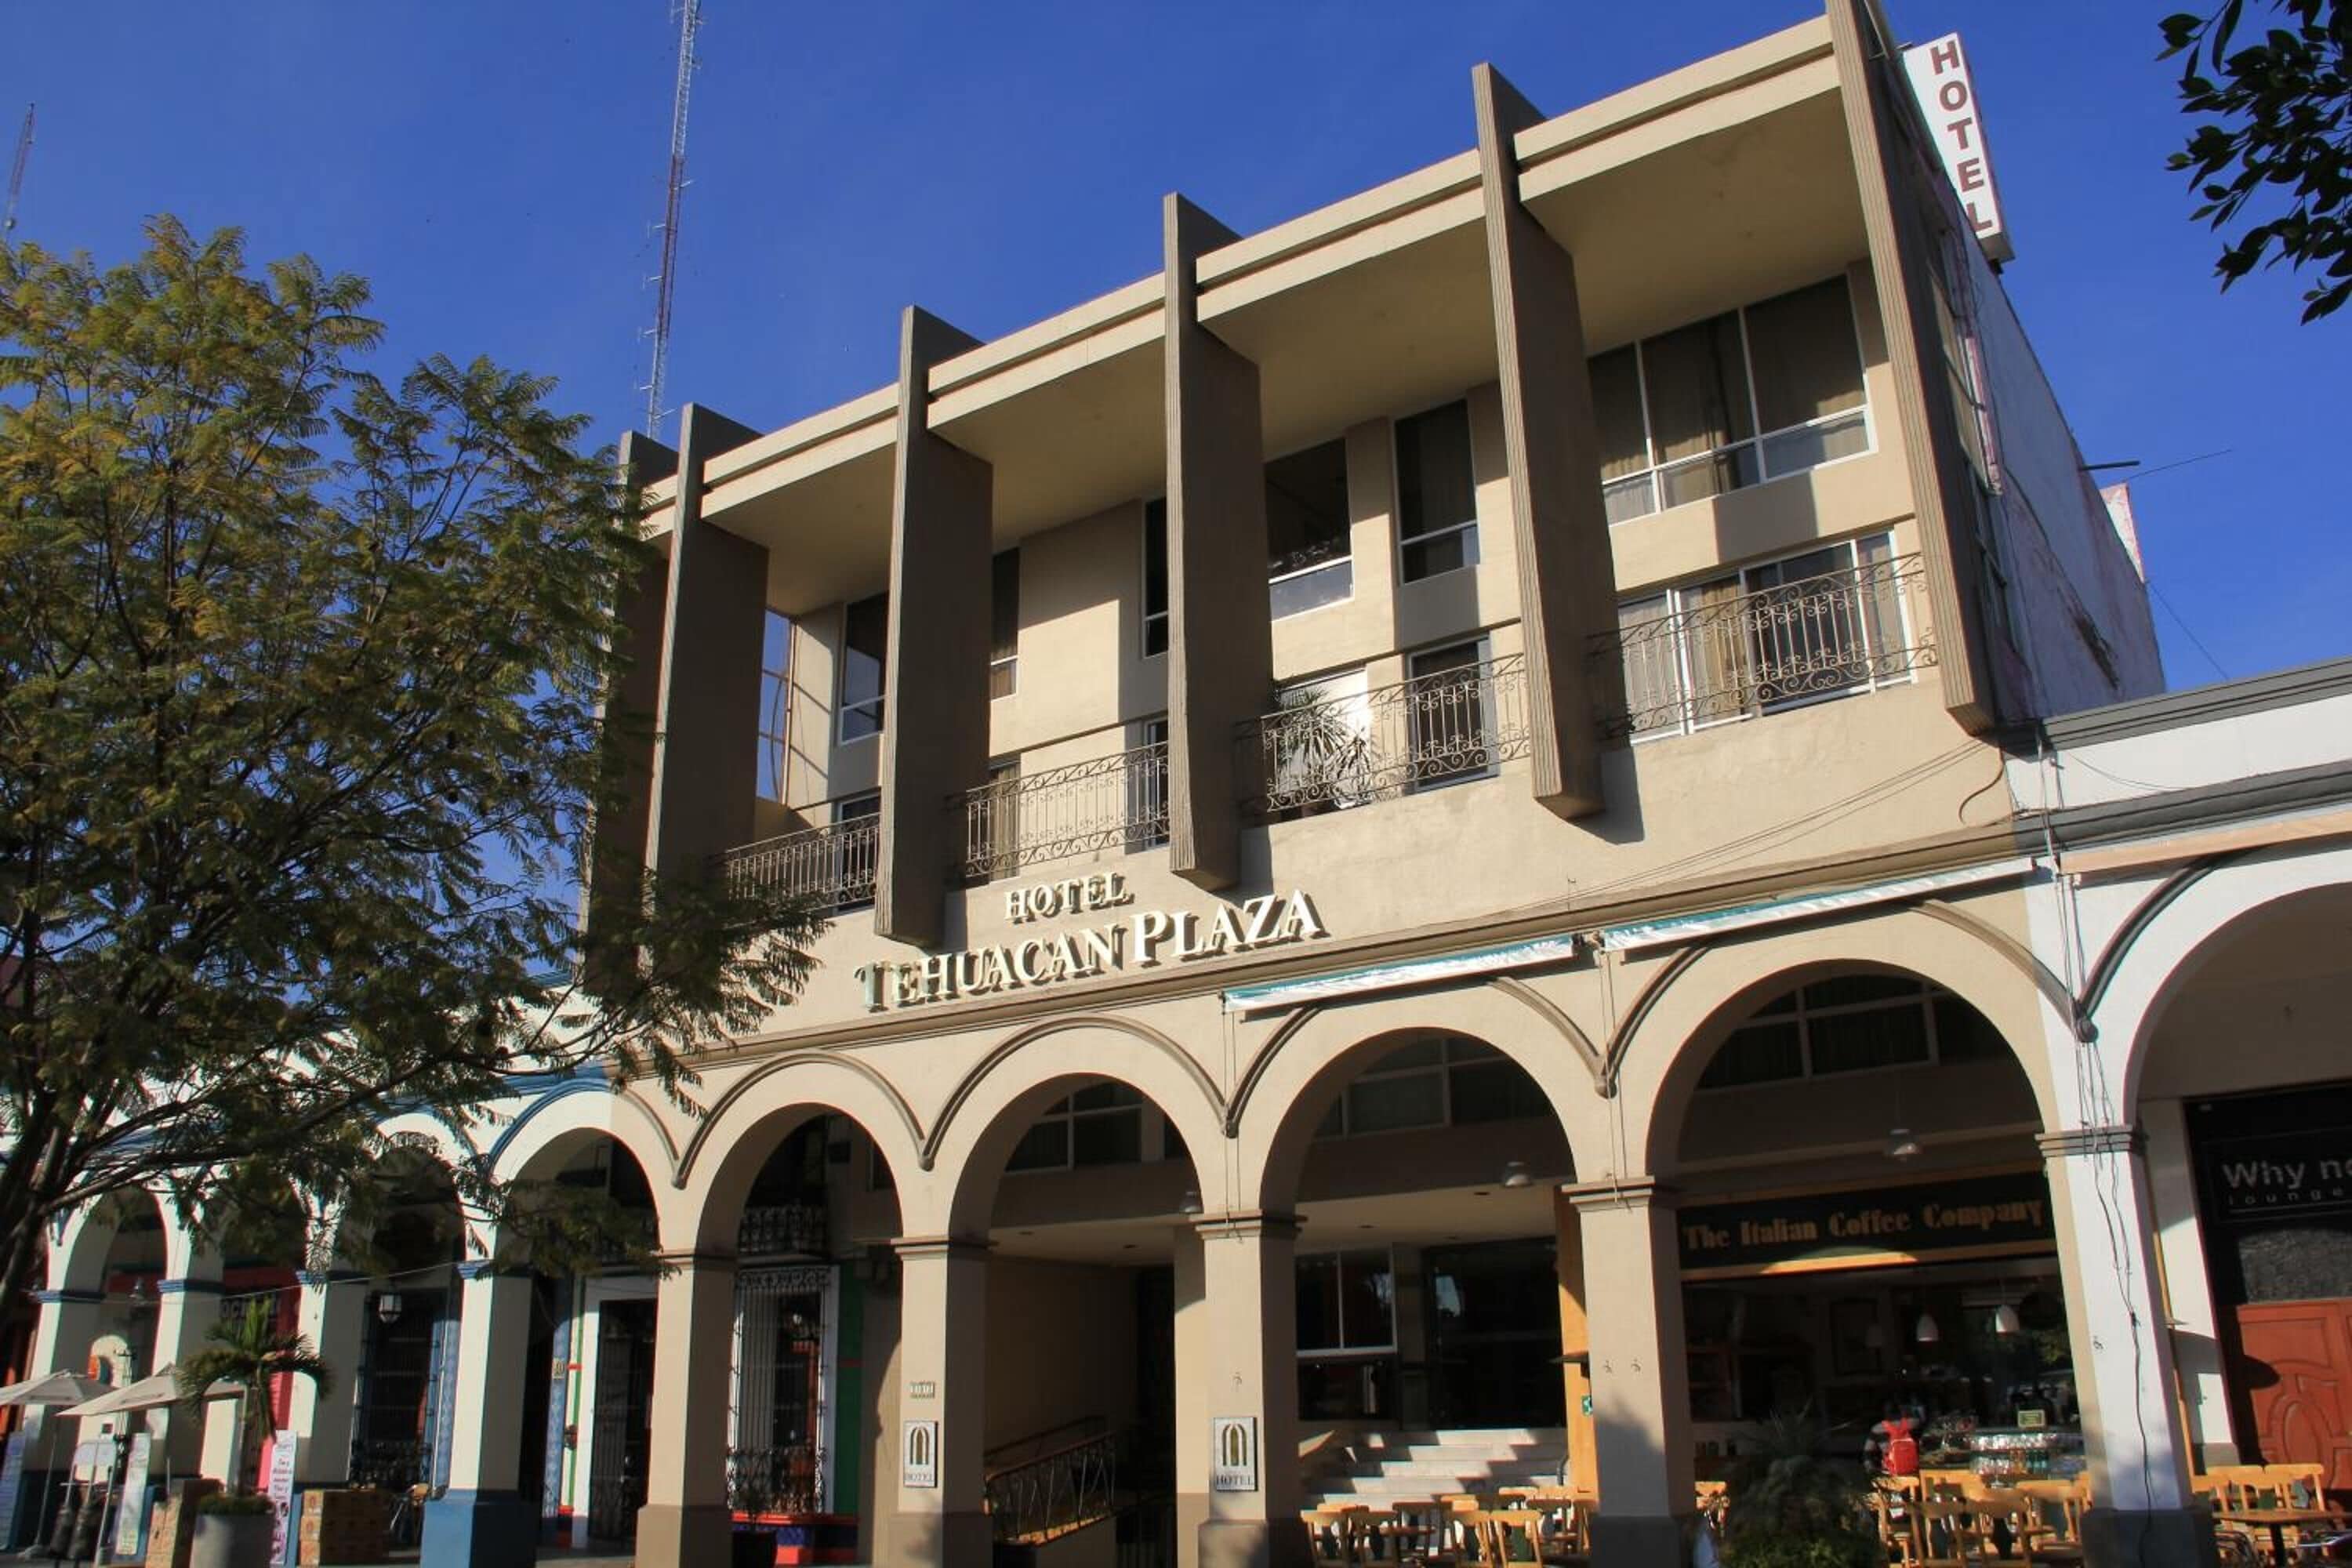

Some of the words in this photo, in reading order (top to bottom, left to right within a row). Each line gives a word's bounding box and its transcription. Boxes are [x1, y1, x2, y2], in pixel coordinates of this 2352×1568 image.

[1929, 41, 1993, 231] HOTEL
[1004, 871, 1131, 920] HOTEL
[855, 922, 1126, 1010] TEHUACAN
[1130, 889, 1324, 963] PLAZA
[2221, 1160, 2305, 1189] Why
[1683, 1224, 1730, 1250] The
[1740, 1218, 1817, 1245] Italian
[1829, 1209, 1911, 1236] Coffee
[1923, 1200, 2043, 1230] Company
[1215, 1475, 1254, 1486] HOTEL
